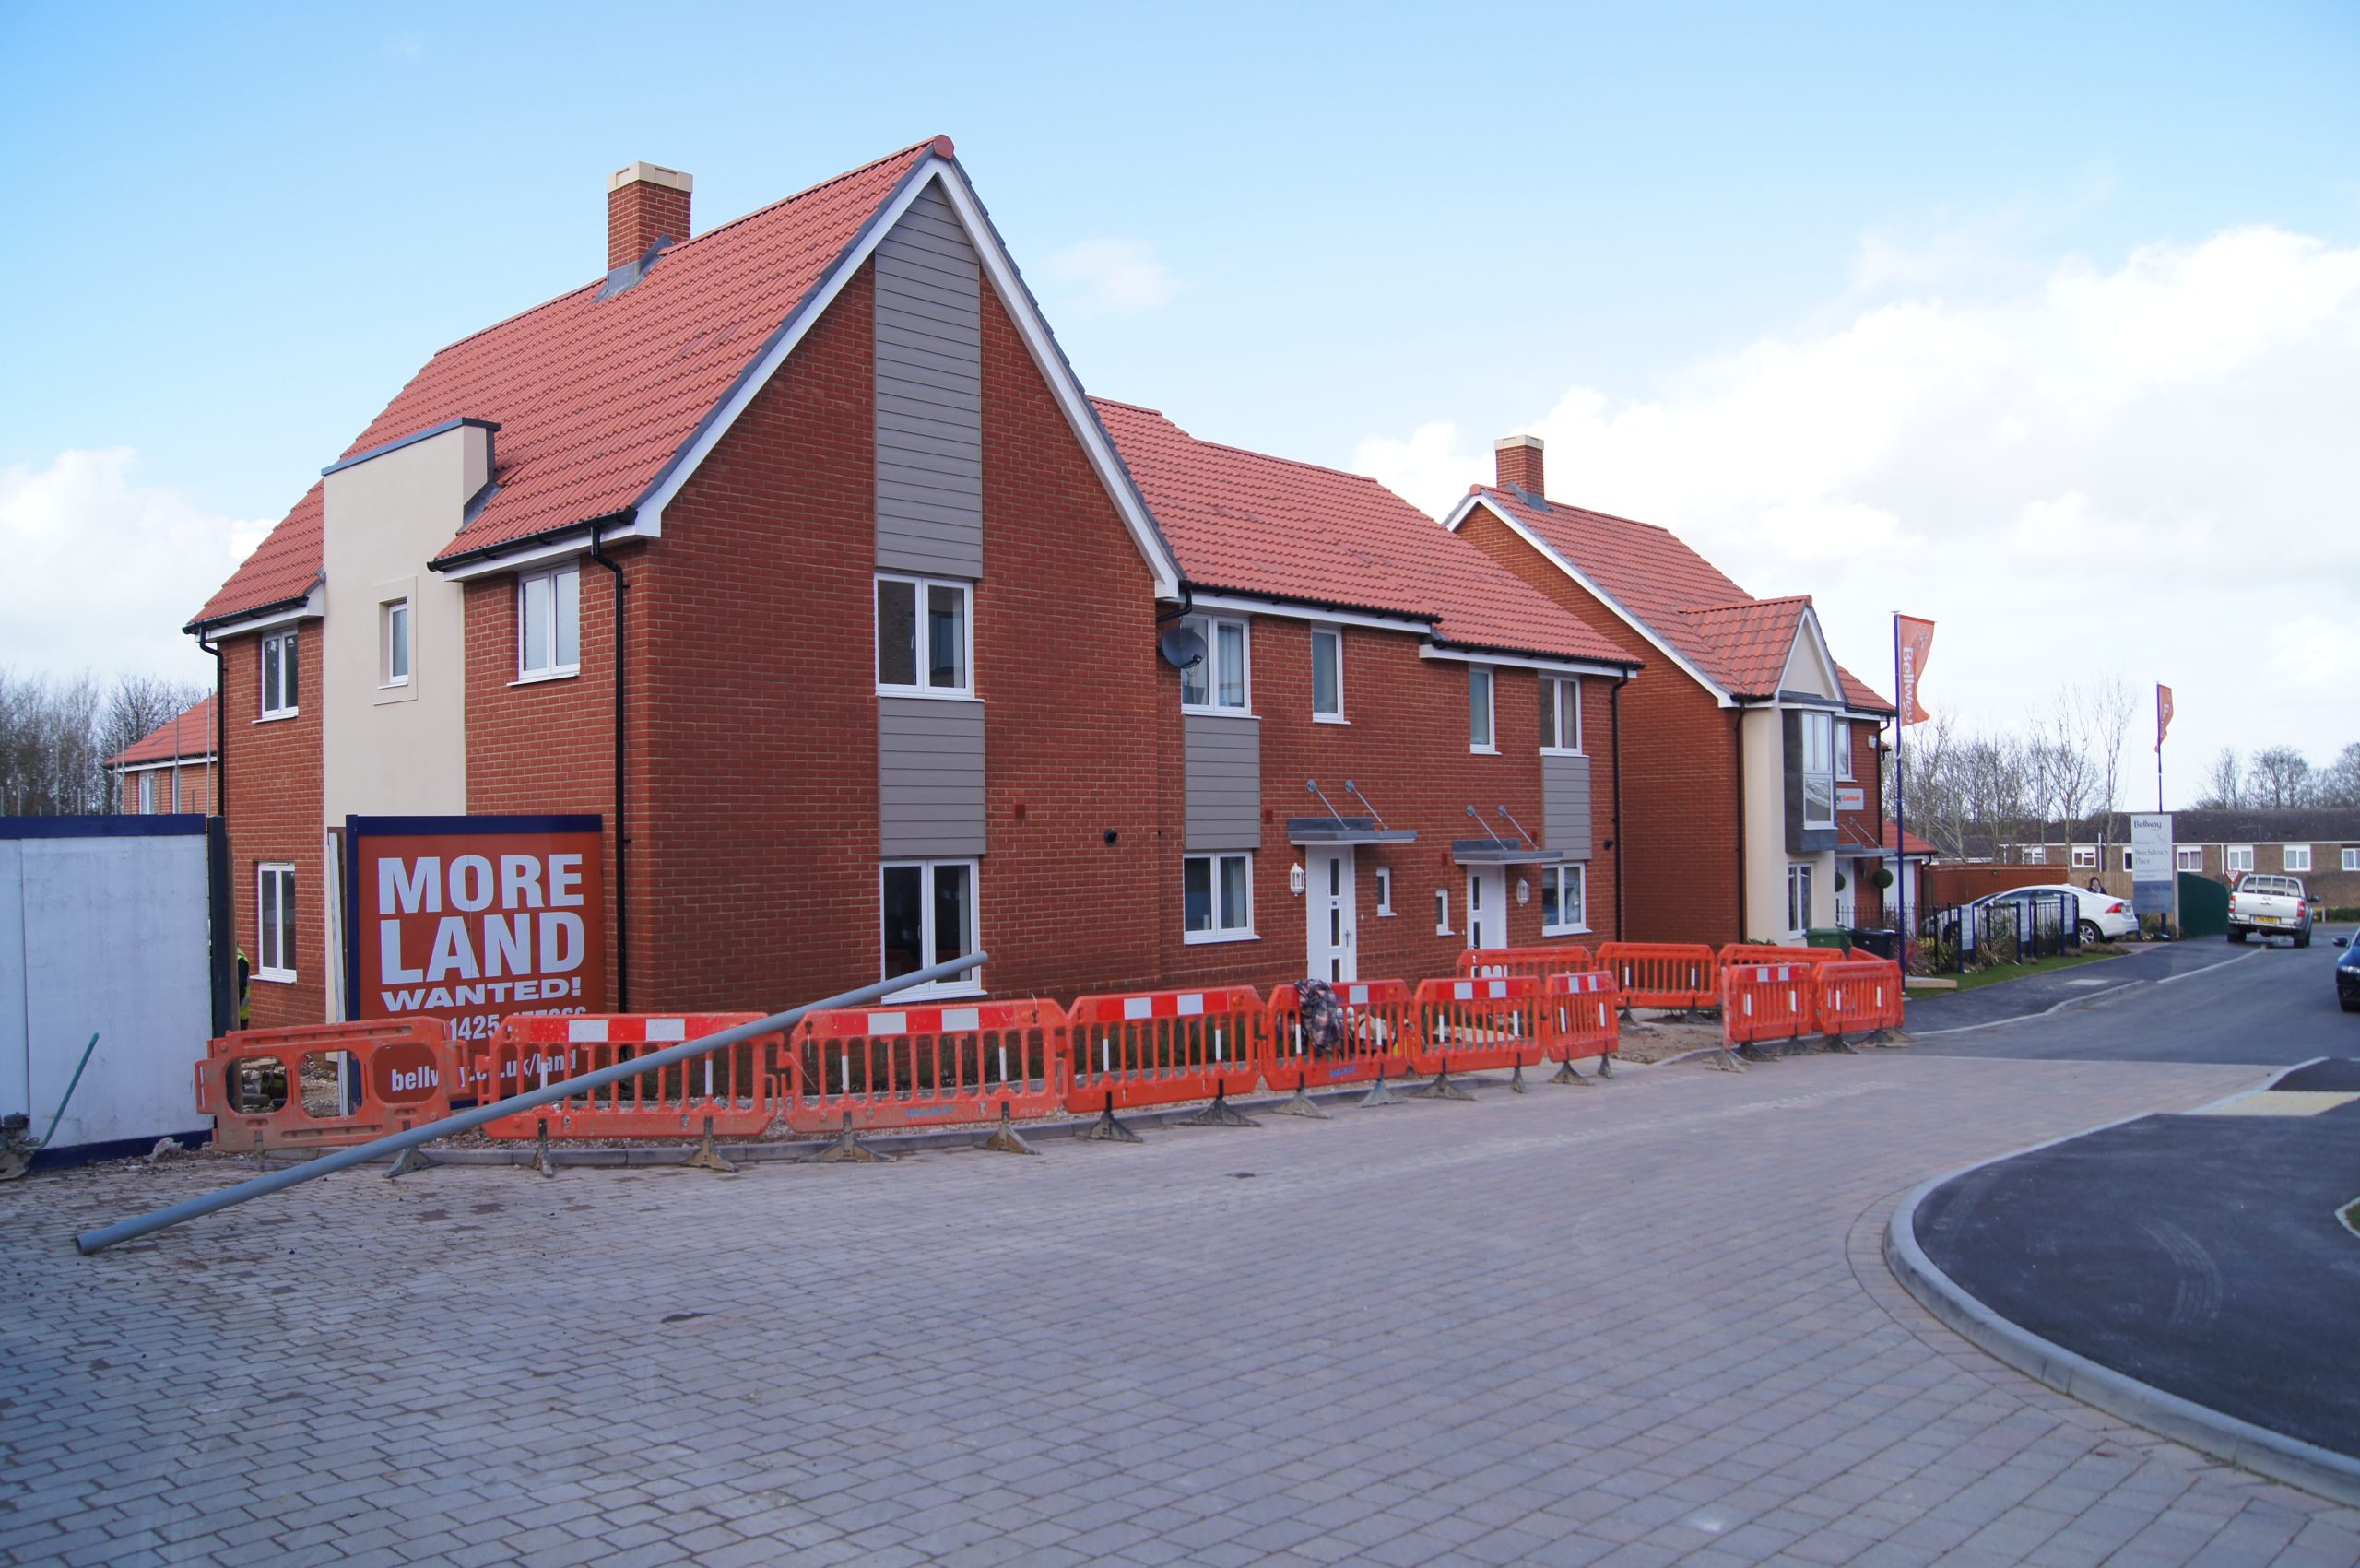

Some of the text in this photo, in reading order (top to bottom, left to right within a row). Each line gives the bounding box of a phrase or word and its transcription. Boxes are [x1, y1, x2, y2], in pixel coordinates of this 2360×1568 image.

[2133, 820, 2162, 829] Bellway
[378, 853, 584, 914] MORE
[380, 911, 585, 985] LAND
[381, 976, 582, 1012] WANTED!
[449, 1013, 501, 1042] 1425
